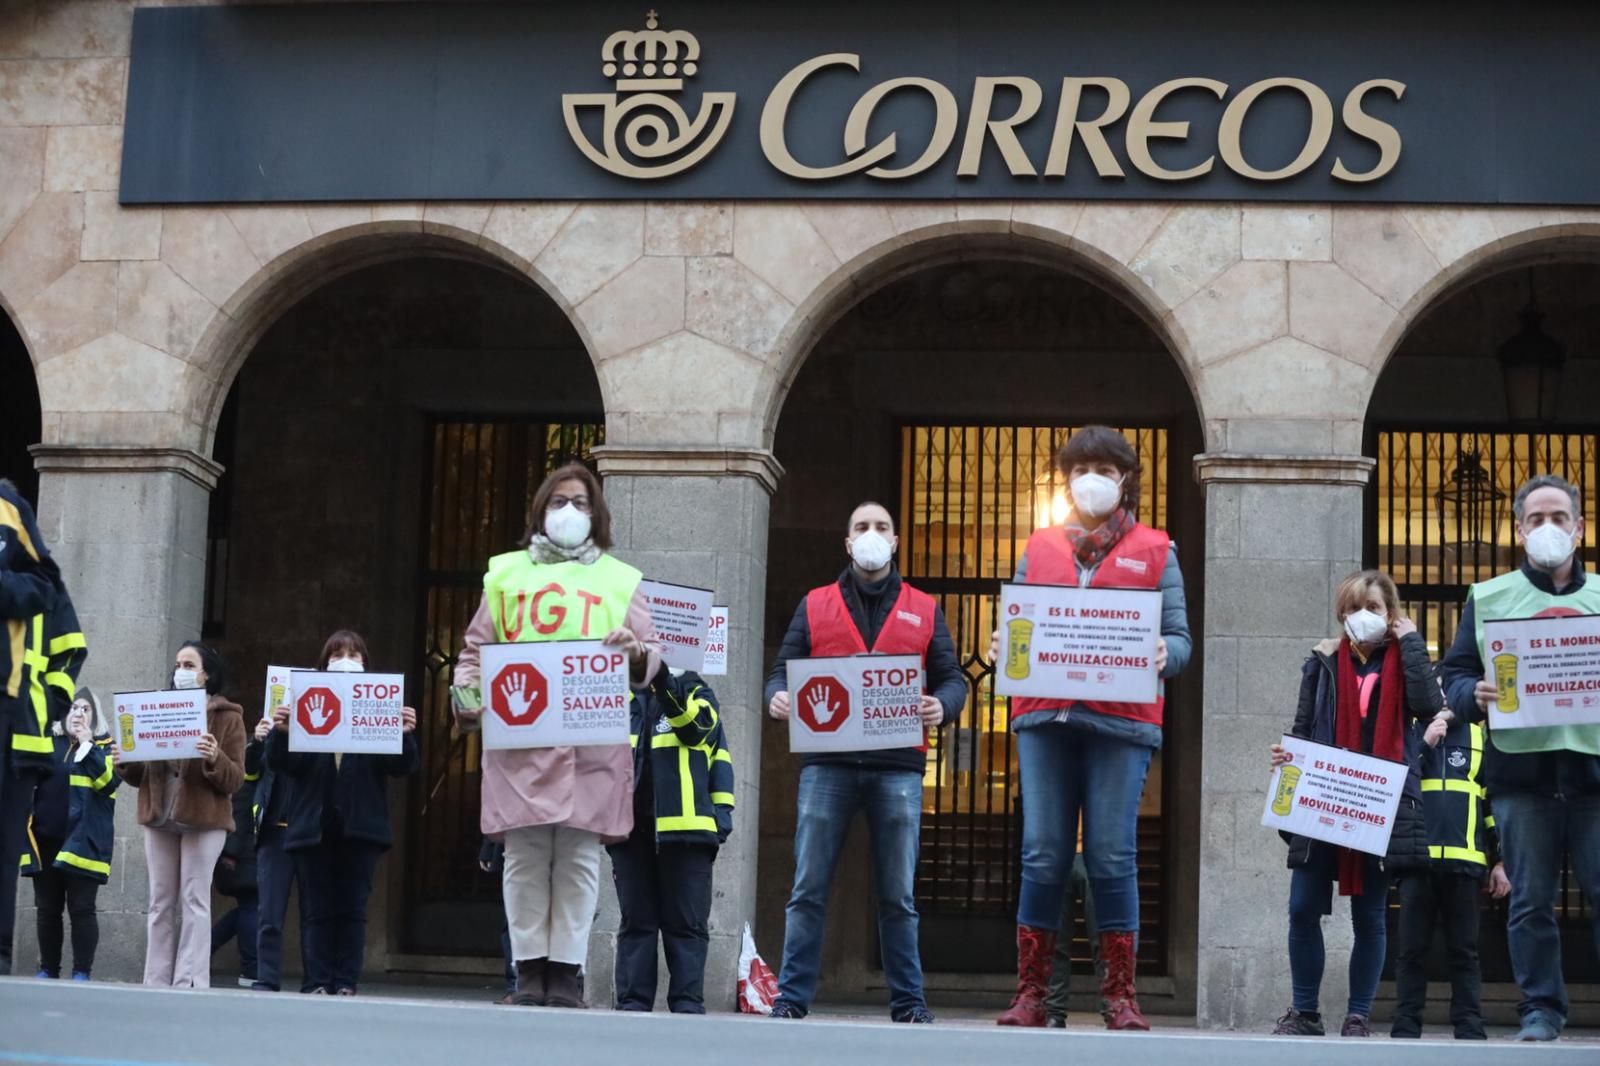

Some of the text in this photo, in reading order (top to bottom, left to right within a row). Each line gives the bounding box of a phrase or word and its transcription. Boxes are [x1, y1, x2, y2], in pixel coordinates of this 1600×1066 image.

[760, 52, 1407, 182] CORREOS
[653, 597, 697, 610] MOMENTO
[498, 582, 602, 641] UGT
[1049, 607, 1140, 620] ES EL MOMENTO
[656, 632, 700, 646] ACIONES
[1530, 636, 1600, 648] ES EL MOMEN
[562, 654, 624, 675] STOP
[1038, 652, 1148, 667] MOVILIZACIONES
[562, 675, 624, 686] DESGUACE
[862, 669, 918, 688] STOP
[353, 684, 400, 699] STOP
[562, 686, 624, 696] DE CORREOS
[862, 687, 918, 698] DESGUACE
[563, 696, 624, 711] SALVAR
[876, 697, 919, 705] CORREOS
[563, 710, 625, 721] EL SERVICIO
[864, 705, 918, 720] SALVAR
[352, 716, 399, 726] SALVAR
[864, 718, 919, 729] EL SERVICIO
[139, 730, 201, 739] MOVILIZACIONES
[1315, 760, 1387, 785] ES EL MOMENTO
[1299, 796, 1386, 826] MOVILIZACIONES
